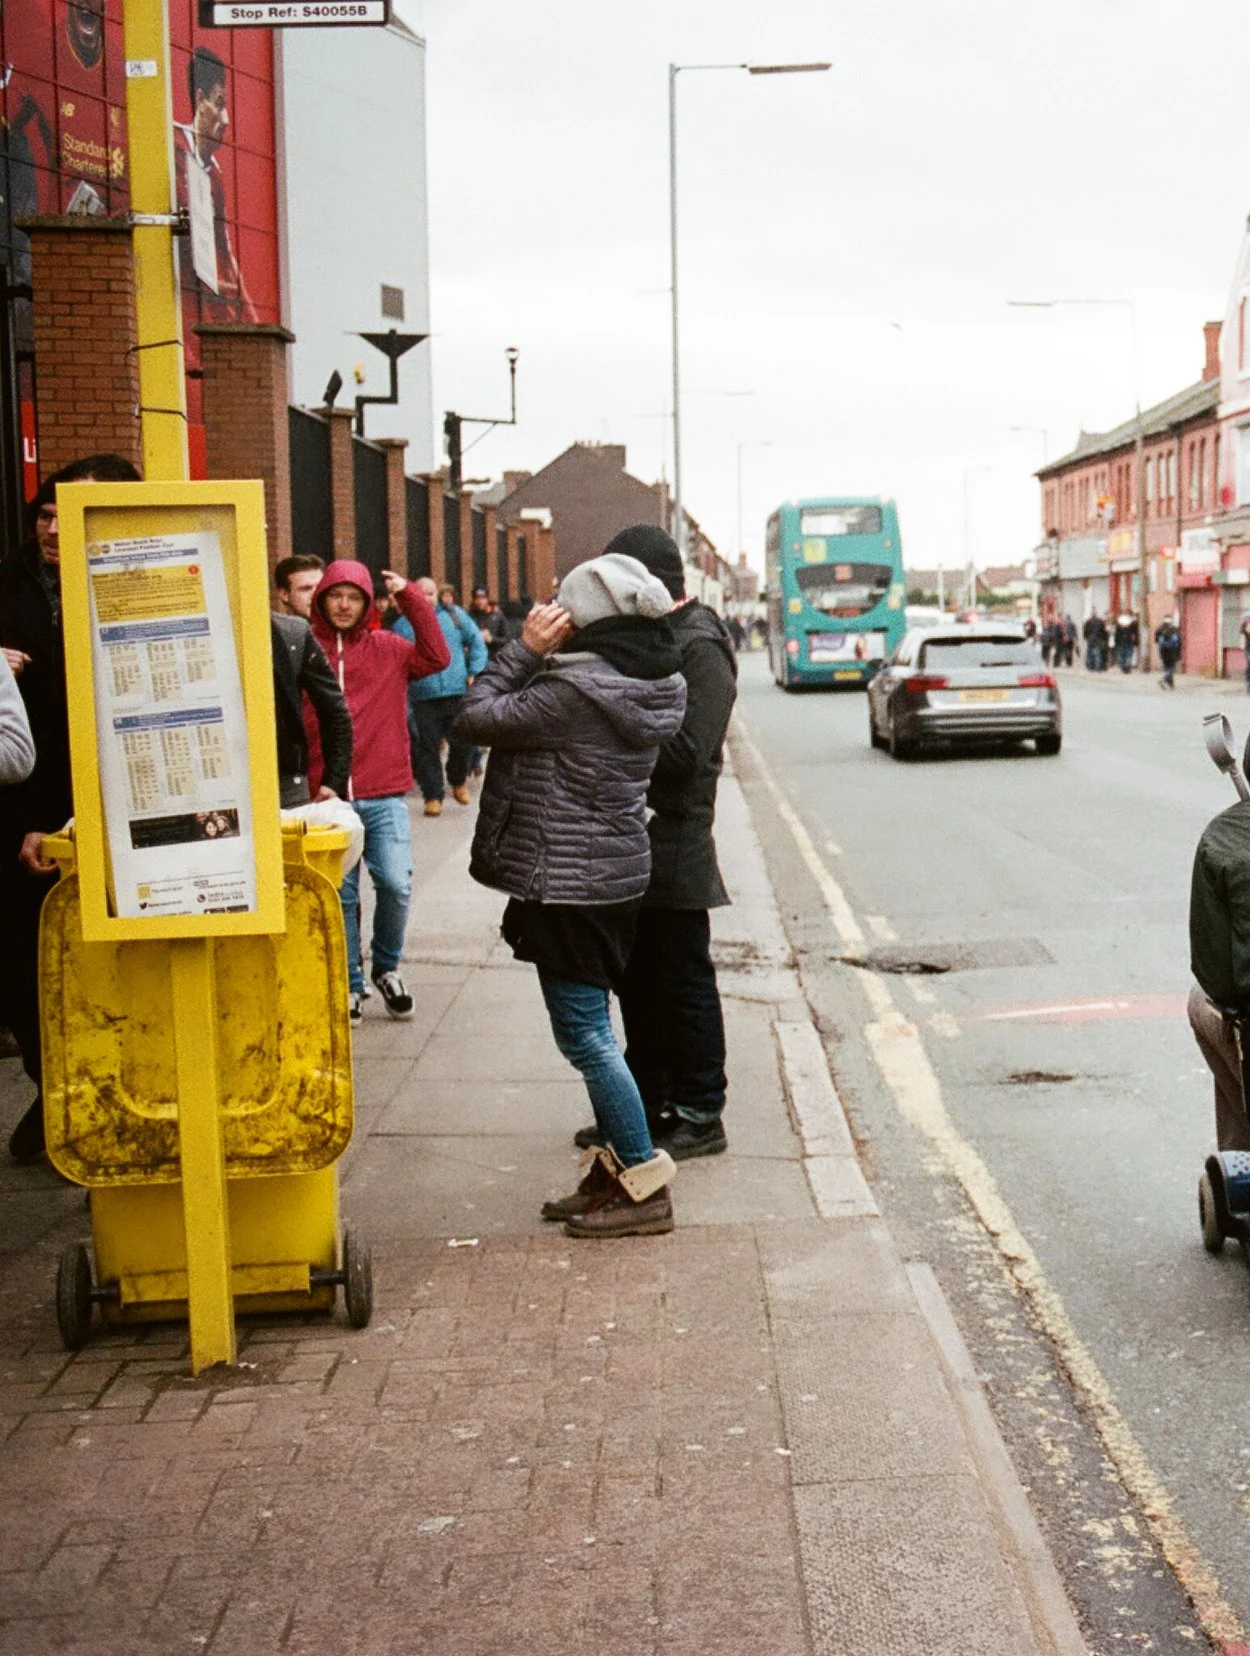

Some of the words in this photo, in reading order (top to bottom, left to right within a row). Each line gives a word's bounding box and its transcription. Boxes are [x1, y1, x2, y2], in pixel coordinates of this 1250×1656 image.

[231, 8, 263, 20] Stop
[268, 7, 298, 18] Ref:
[302, 6, 368, 17] S40055B
